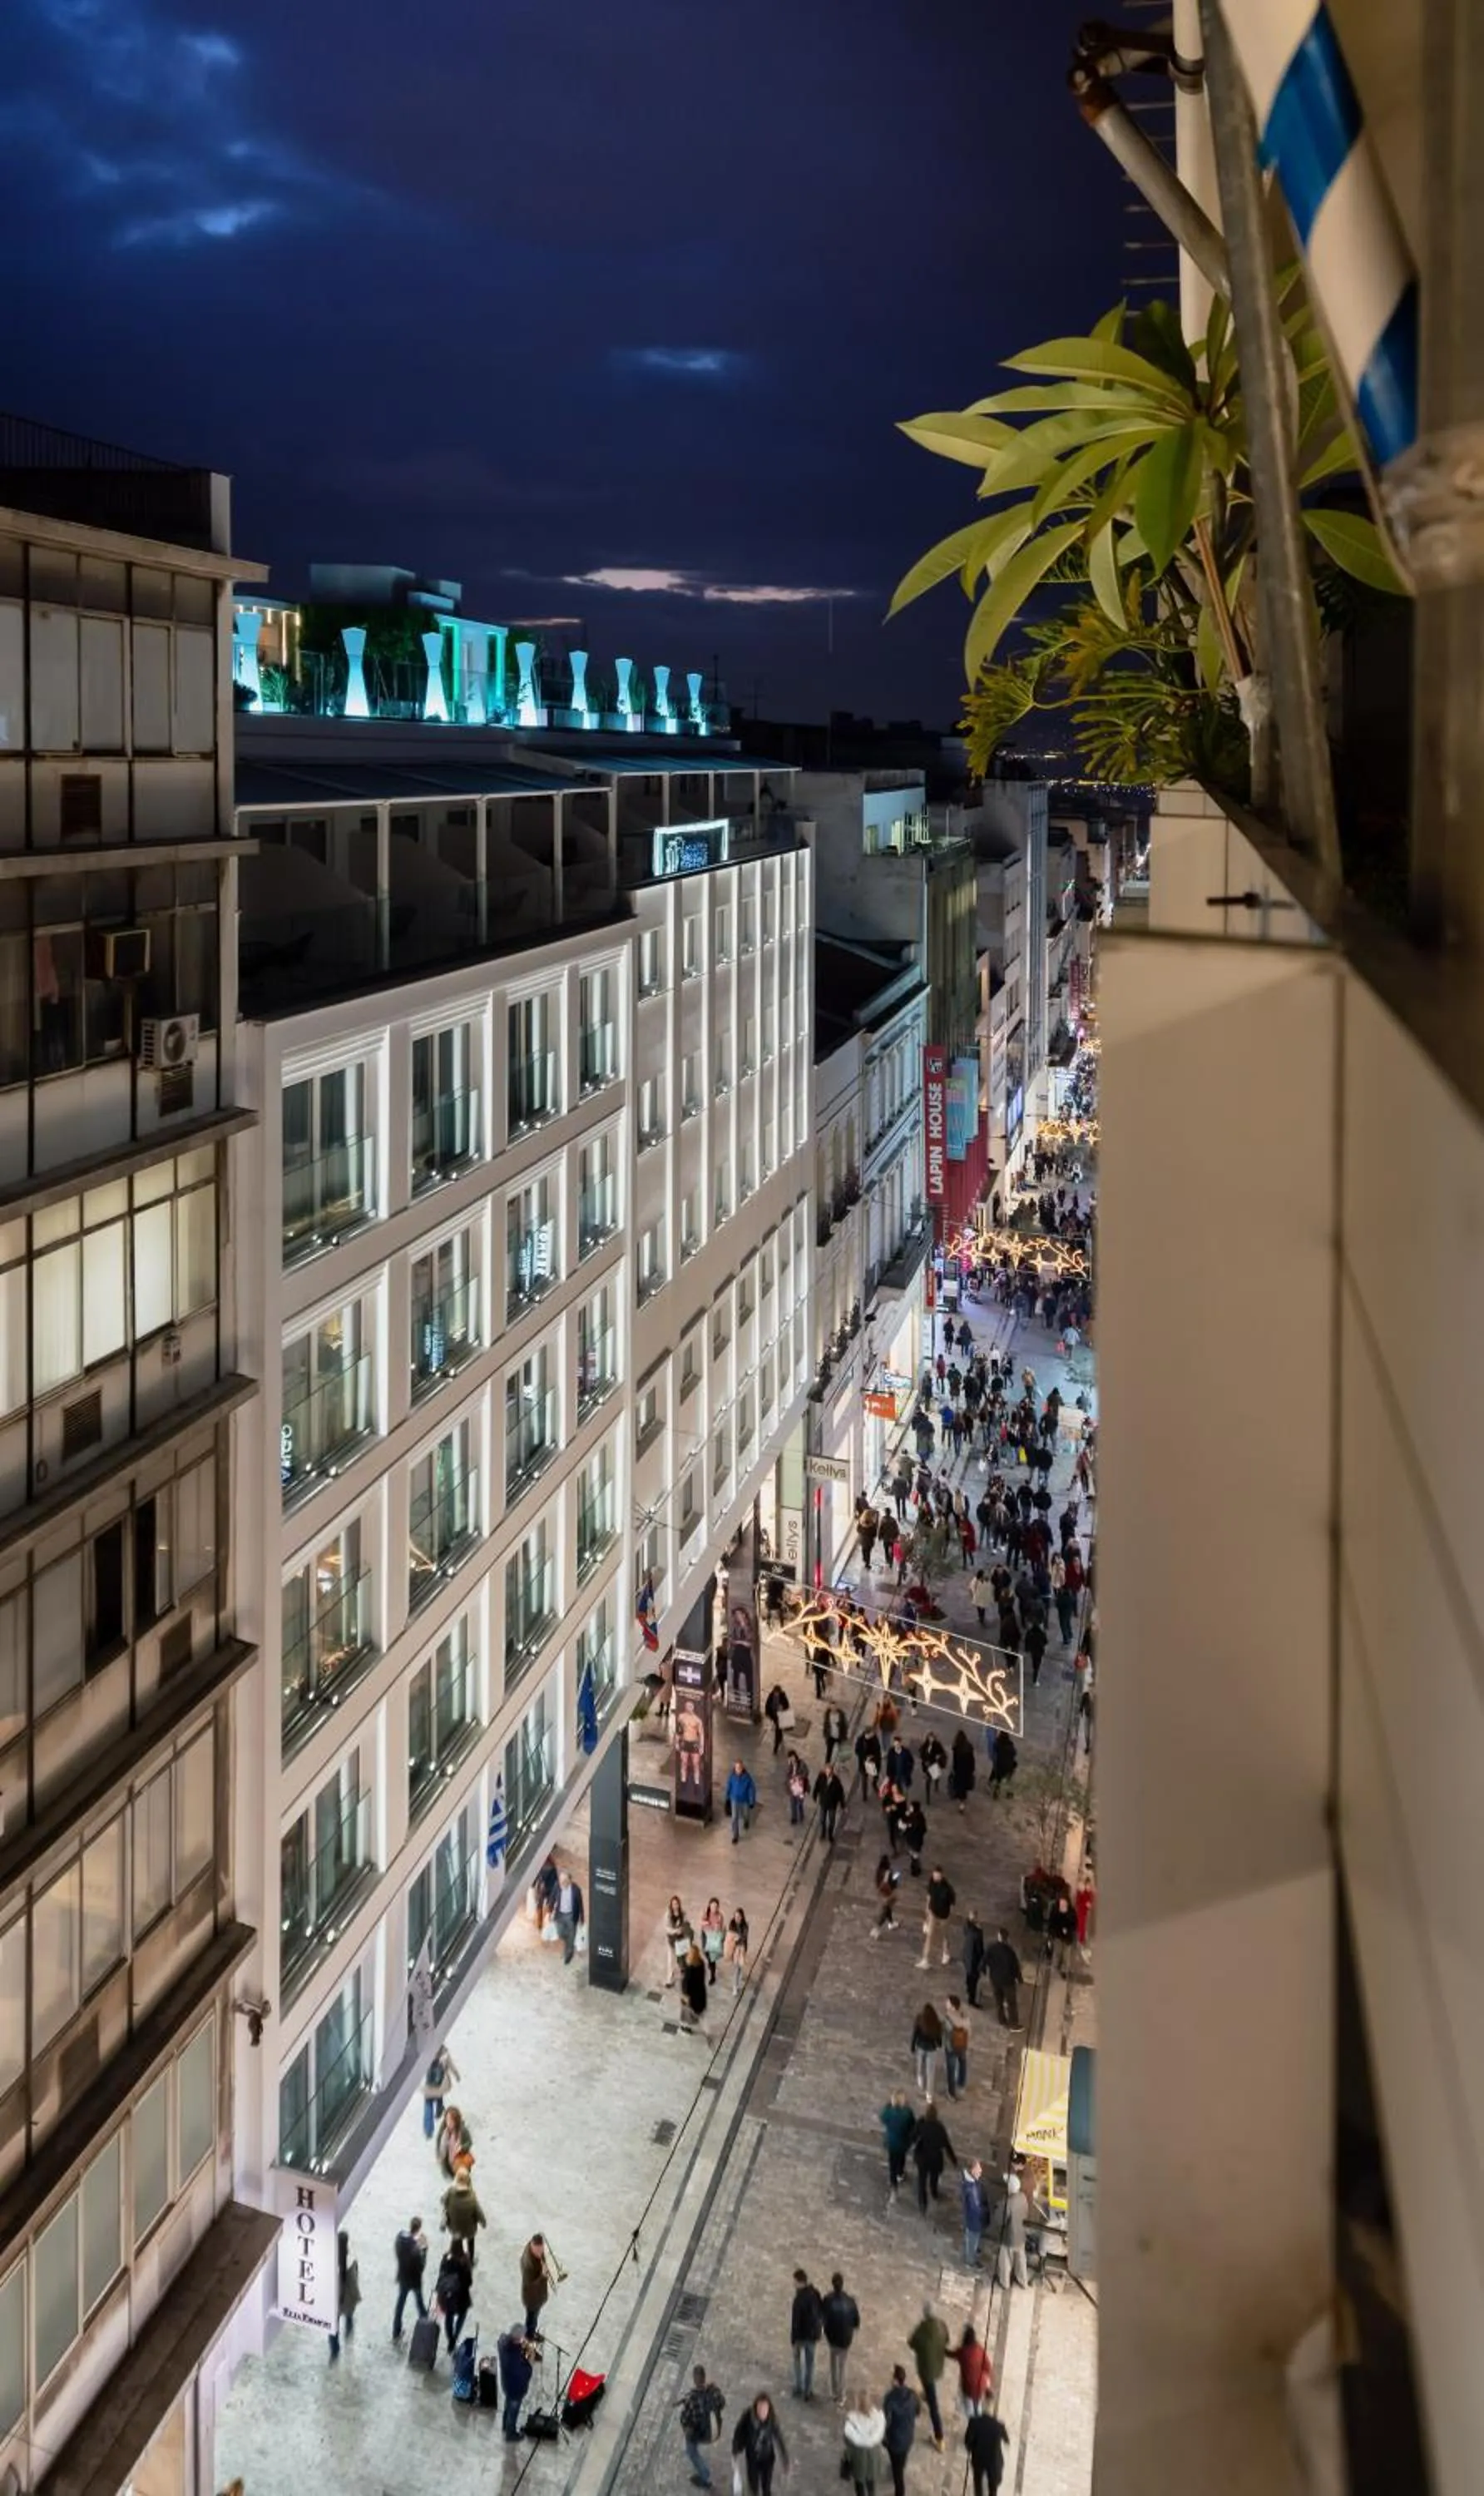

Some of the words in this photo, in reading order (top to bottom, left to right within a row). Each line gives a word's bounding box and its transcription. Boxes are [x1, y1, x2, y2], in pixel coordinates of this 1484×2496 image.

[928, 1082, 942, 1139] HOUSE
[929, 1146, 944, 1195] LAPIN
[788, 1520, 799, 1560] ellys
[297, 2186, 314, 2305] HOTEL
